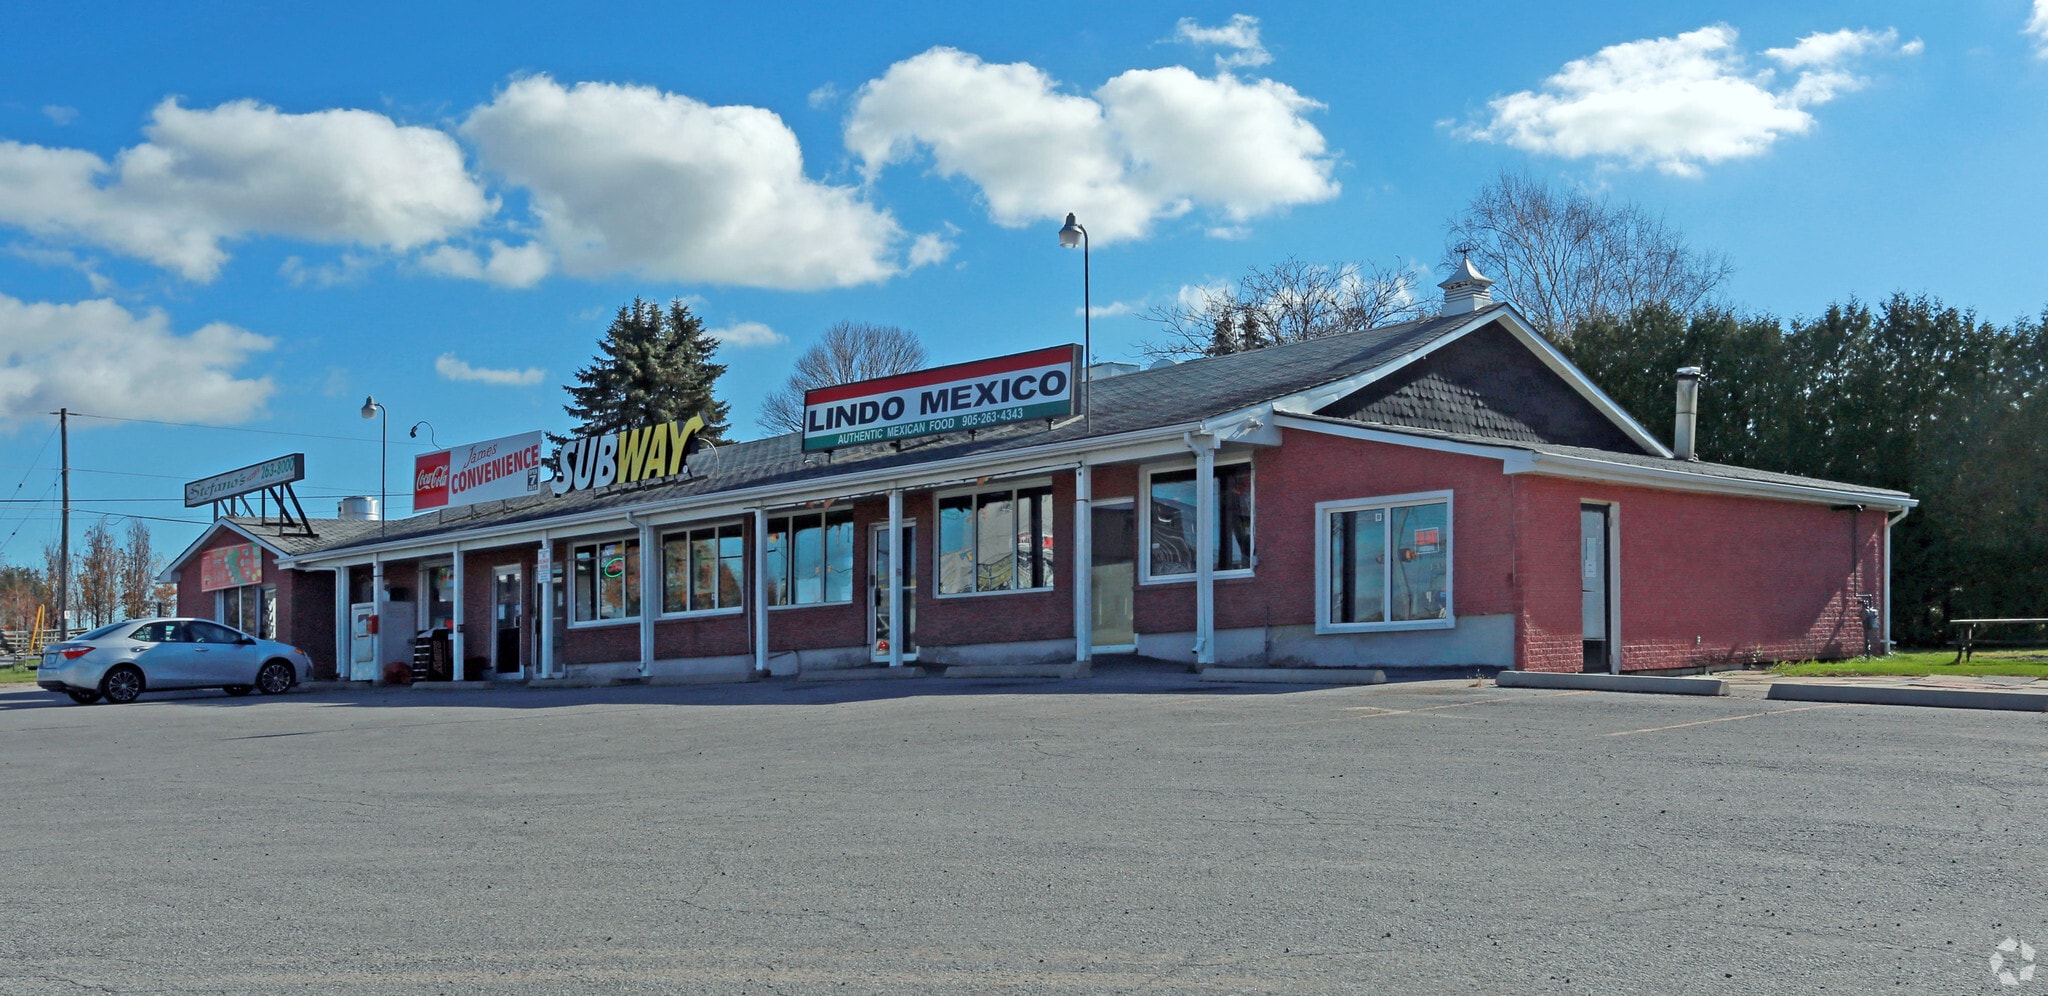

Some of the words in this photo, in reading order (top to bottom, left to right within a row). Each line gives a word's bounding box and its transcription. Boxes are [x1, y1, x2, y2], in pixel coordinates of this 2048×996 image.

[808, 396, 905, 433] LINDO
[920, 370, 1067, 415] MEXICO
[837, 428, 883, 445] AUTHENTIC
[887, 421, 926, 438] MEXICAN
[929, 417, 955, 432] FOOD
[451, 444, 539, 494] CONVENIENCE
[463, 443, 498, 469] James
[549, 411, 706, 495] SUBWAY
[186, 474, 246, 500] Stefano's
[261, 457, 294, 480] 263-8000
[529, 475, 537, 485] 7
